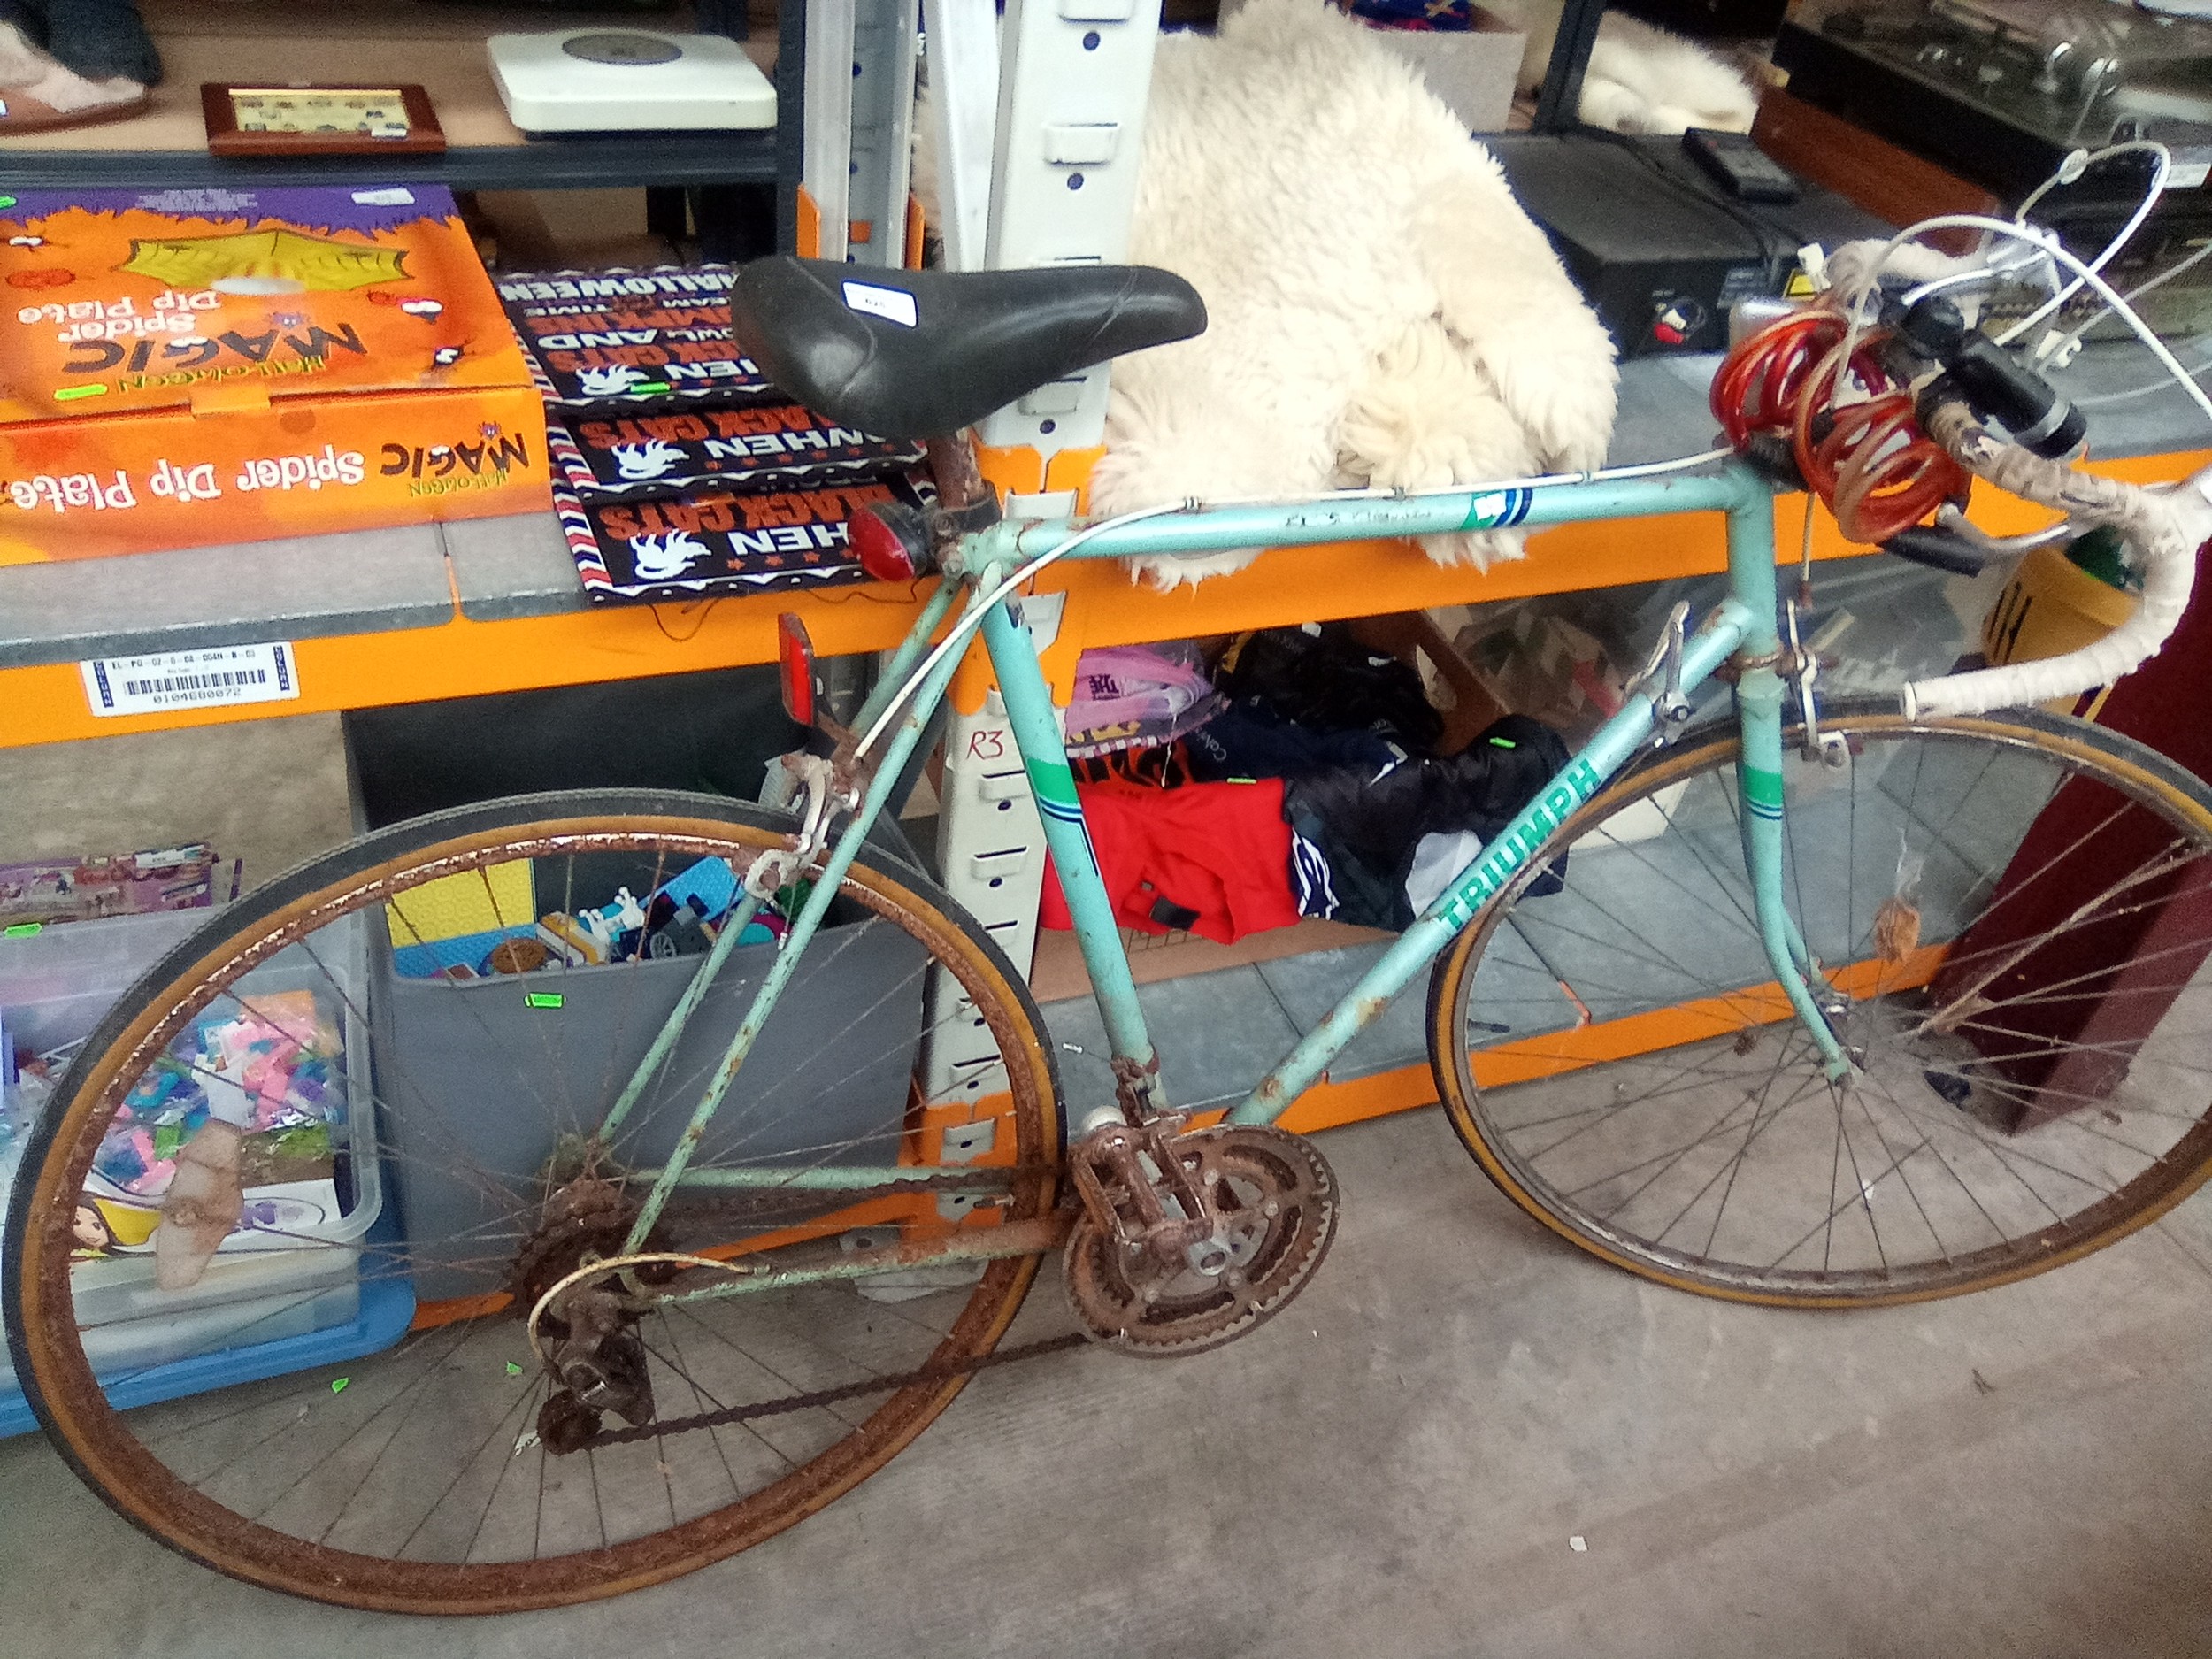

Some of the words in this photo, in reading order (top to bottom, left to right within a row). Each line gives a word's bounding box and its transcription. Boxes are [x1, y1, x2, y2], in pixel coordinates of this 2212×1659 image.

[17, 296, 133, 325] Plate
[152, 289, 220, 313] Dip
[58, 311, 196, 343] Spider
[538, 329, 658, 351] AND
[62, 322, 368, 375] MAGIC
[235, 444, 365, 491] Spider
[380, 433, 530, 479] MAGIC
[10, 470, 136, 513] Plate
[150, 458, 221, 503] Dip
[728, 522, 849, 556] HEN
[966, 730, 1003, 759] R3
[1437, 758, 1600, 930] TRIUMPH
